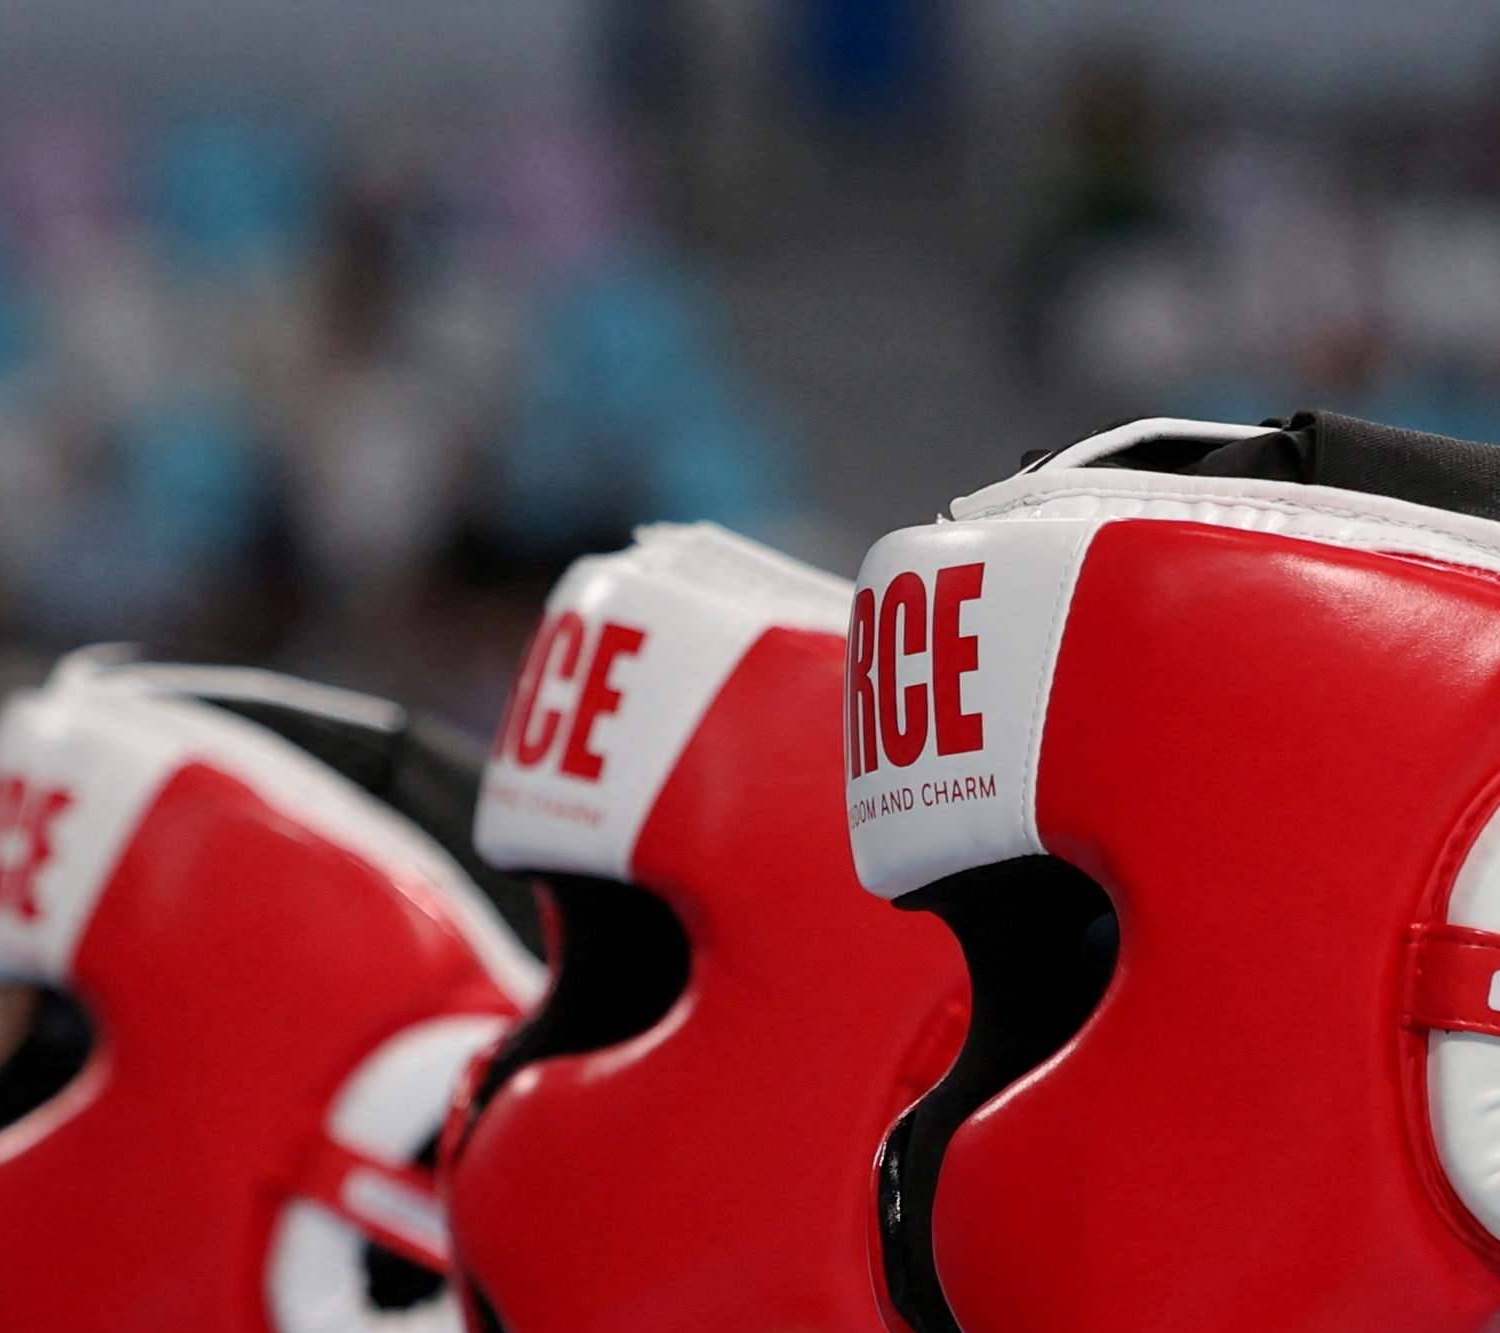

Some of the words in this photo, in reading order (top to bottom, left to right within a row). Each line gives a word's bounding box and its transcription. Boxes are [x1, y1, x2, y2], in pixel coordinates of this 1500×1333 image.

[849, 561, 986, 780] RCE
[880, 787, 914, 817] AND
[921, 773, 997, 807] CHARM
